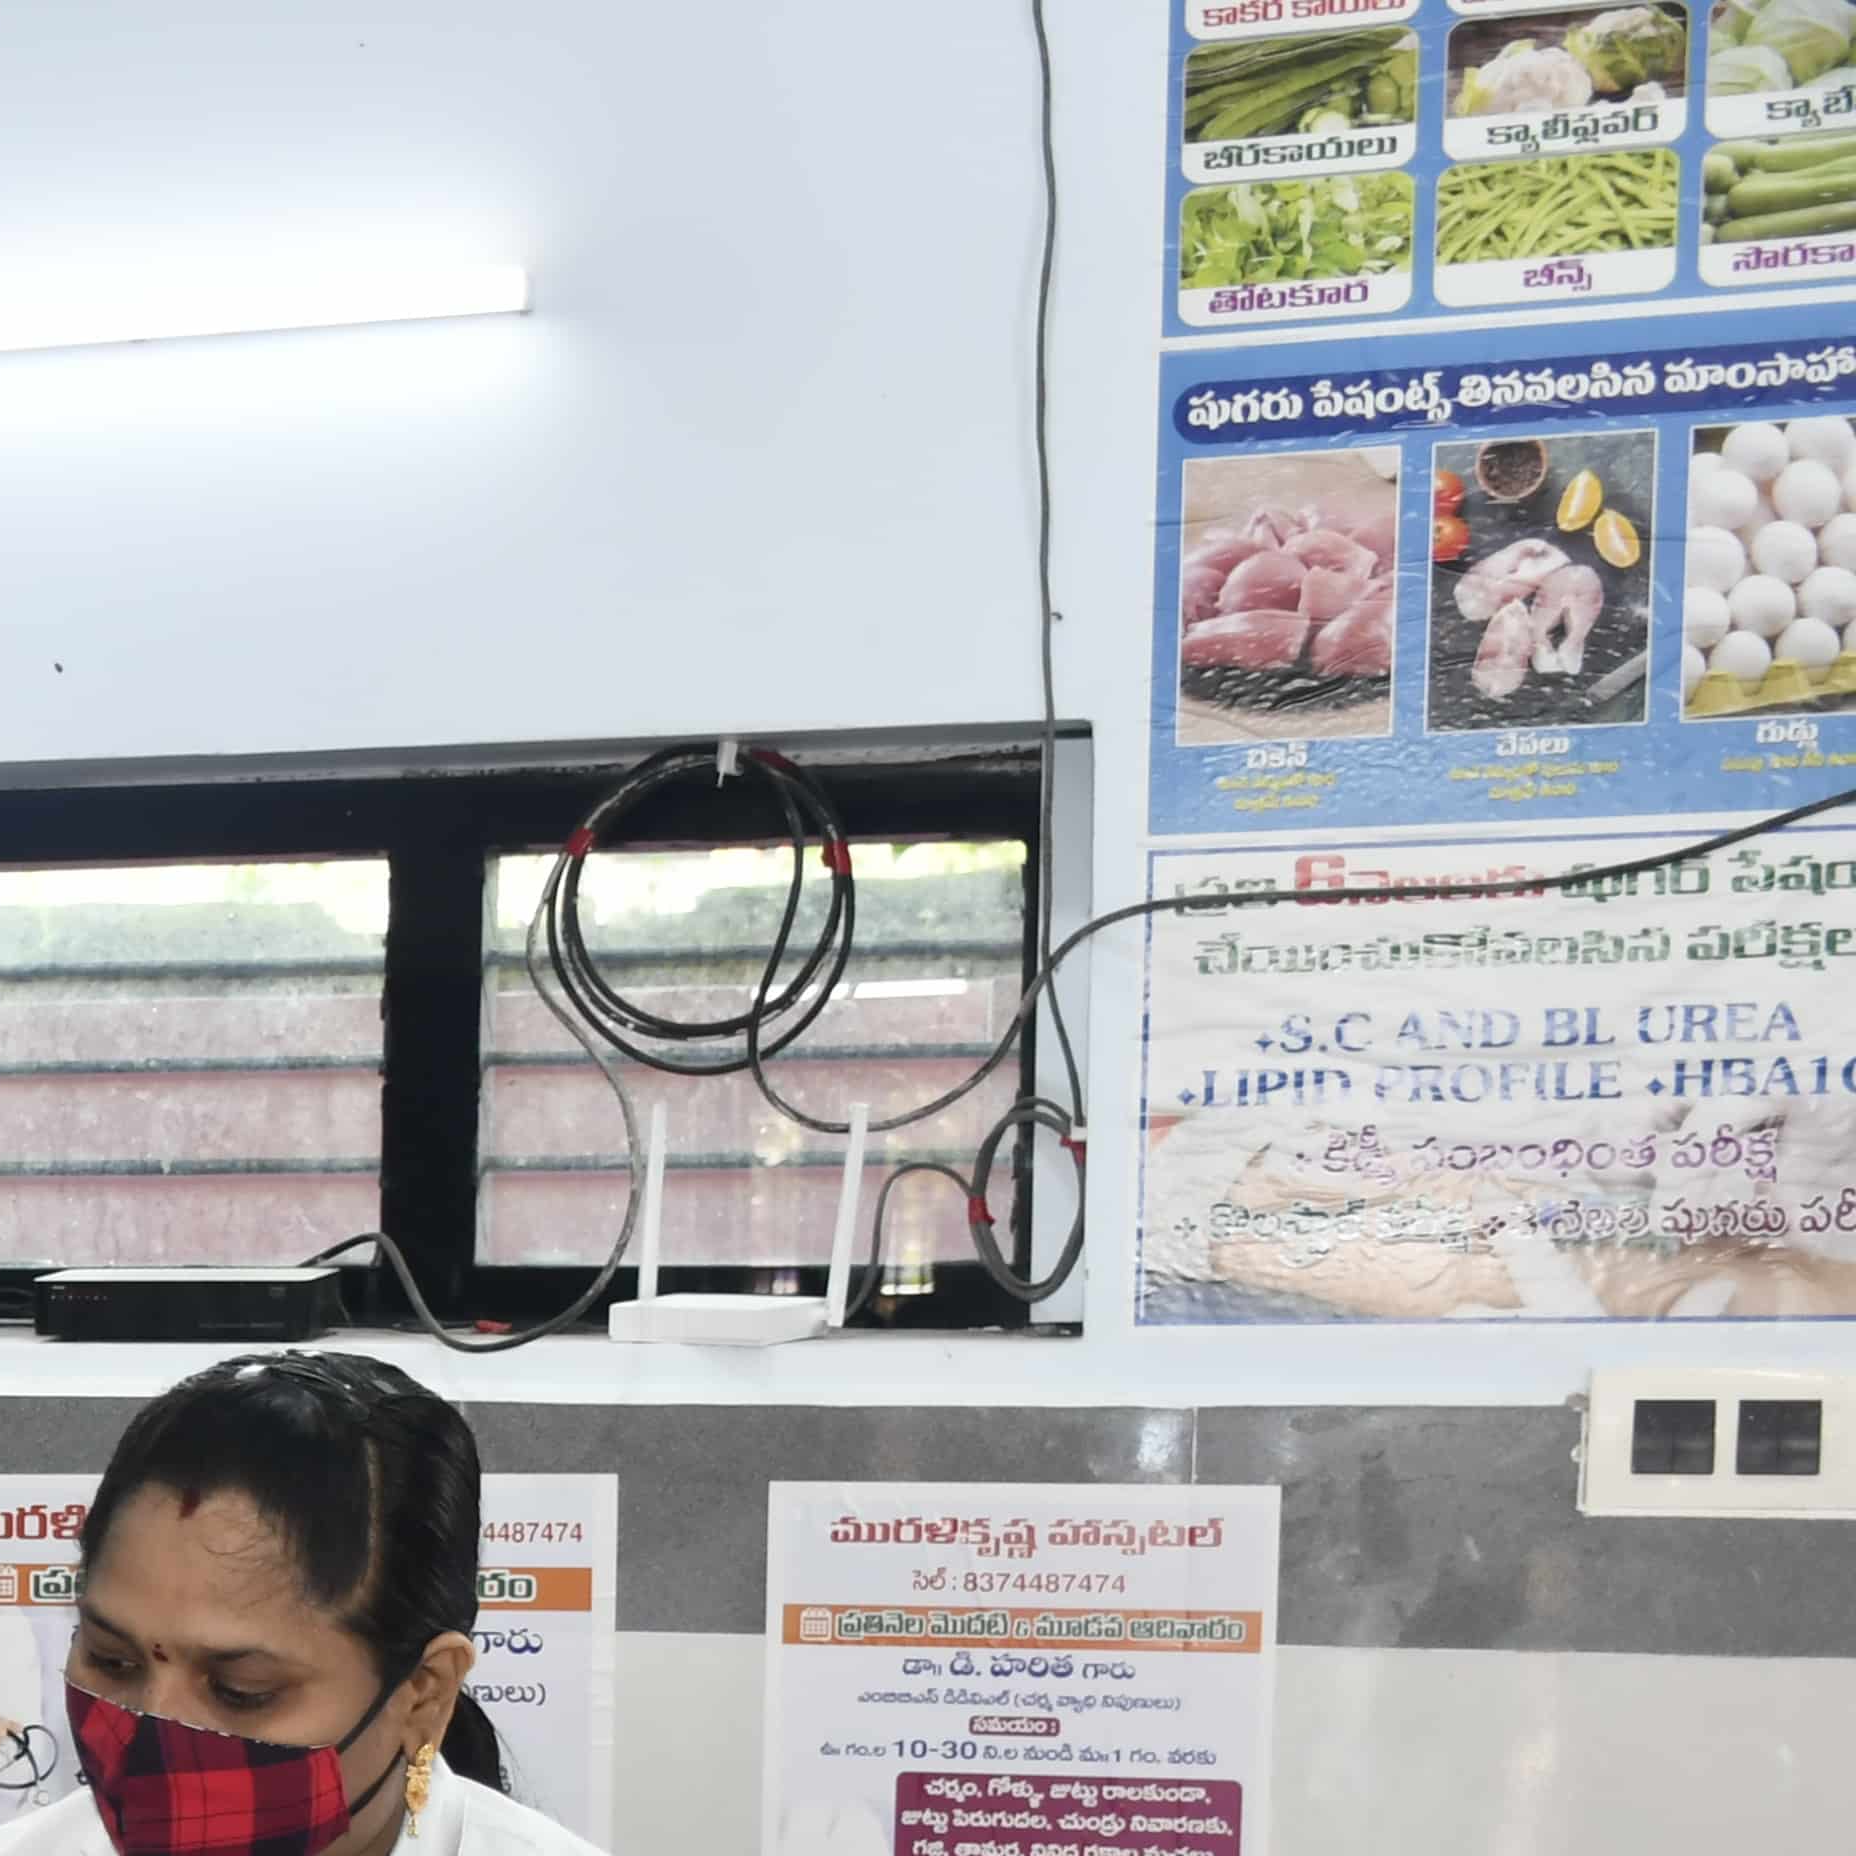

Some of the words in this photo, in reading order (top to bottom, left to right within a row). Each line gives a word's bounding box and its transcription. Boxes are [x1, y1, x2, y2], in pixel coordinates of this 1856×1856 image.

[1204, 133, 1397, 171] బీరకాయలు
[1209, 280, 1368, 316] తోటకూర
[1189, 378, 1303, 429] షుగరు
[1458, 357, 1655, 406] తినవలసిన
[1496, 730, 1570, 758] చేపలు
[1279, 1012, 1372, 1054] S.C
[1397, 1008, 1520, 1050] AND
[1543, 1007, 1616, 1047] BL
[1637, 1001, 1802, 1044] UREA
[1375, 1060, 1623, 1103] PROFILE
[1129, 1618, 1245, 1642] ఆదివారం
[990, 1652, 1074, 1678] హరిత
[1082, 1661, 1135, 1681] గారు
[893, 1739, 977, 1761] 10-30
